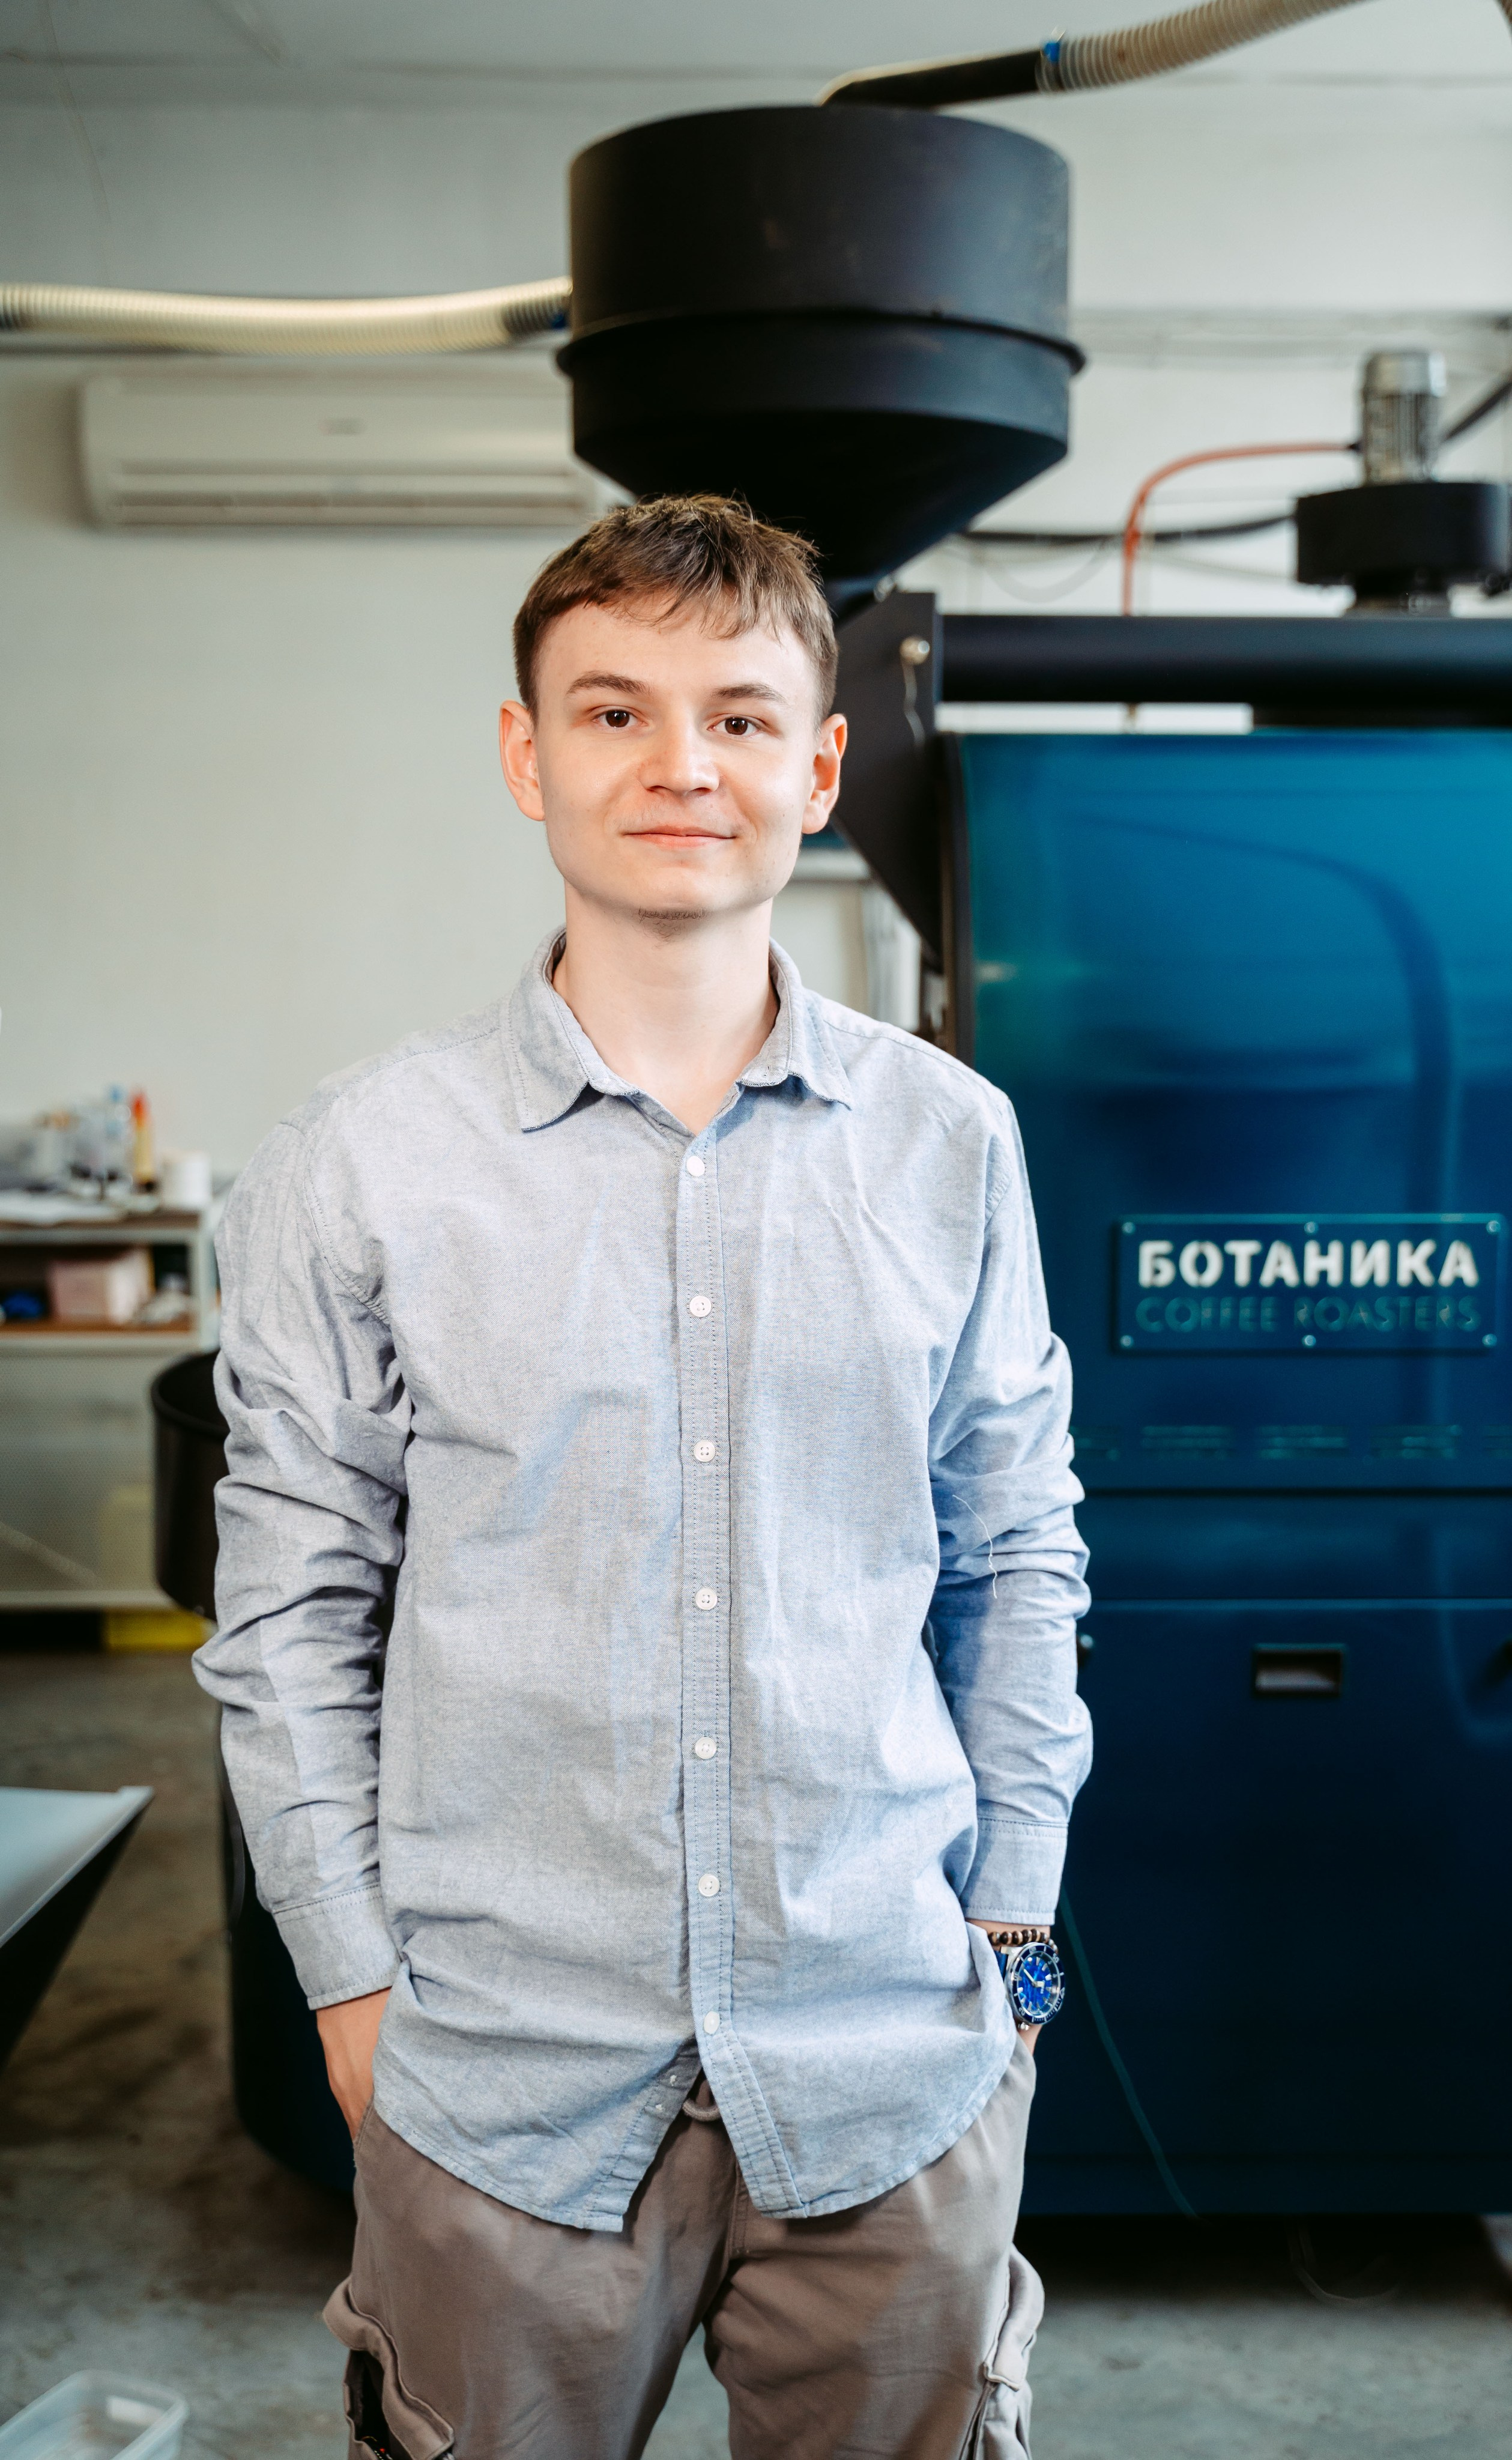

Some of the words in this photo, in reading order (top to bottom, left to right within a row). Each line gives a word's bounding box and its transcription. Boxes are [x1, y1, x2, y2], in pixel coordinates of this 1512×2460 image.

[1139, 1240, 1479, 1288] БОТАНИКА
[1136, 1297, 1278, 1333] COFFEE
[1294, 1296, 1481, 1332] ROASTERS
